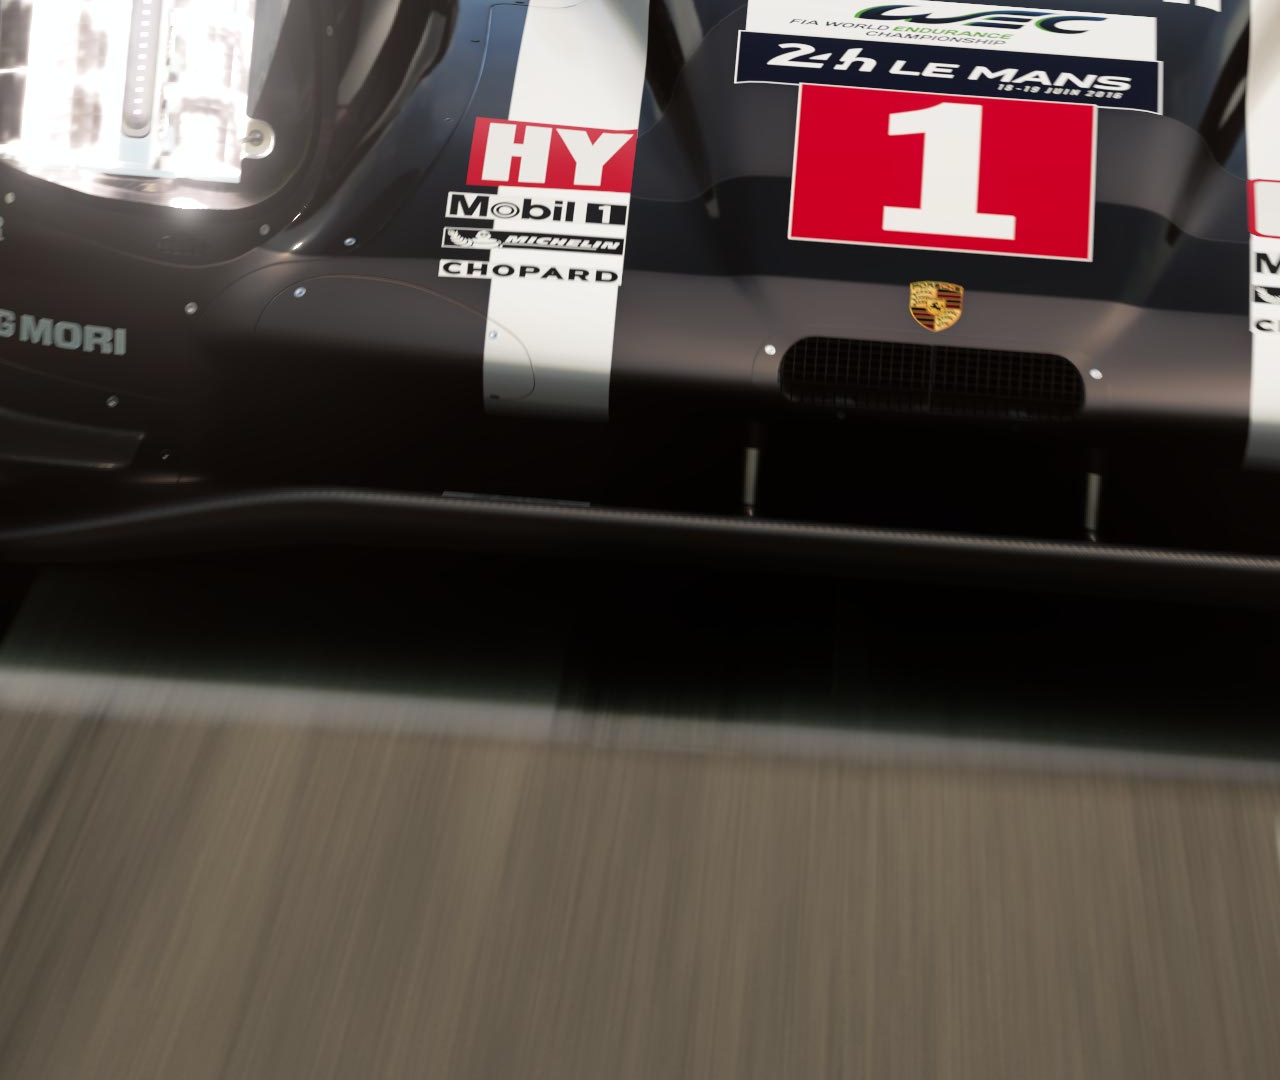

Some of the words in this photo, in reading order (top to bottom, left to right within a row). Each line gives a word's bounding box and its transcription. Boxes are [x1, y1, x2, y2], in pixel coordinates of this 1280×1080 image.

[789, 17, 820, 27] FIA
[821, 20, 890, 32] WORLD
[892, 25, 1015, 40] ENDURANCE
[854, 4, 1108, 35] WEC
[865, 30, 1008, 47] CHAMPIONSHIP
[888, 59, 961, 79] LE
[967, 65, 1133, 92] MANS
[1043, 87, 1081, 97] JUIN
[1084, 89, 1124, 100] 2016
[481, 122, 635, 187] HY
[881, 101, 1017, 241] 1
[449, 194, 576, 223] Mobil
[502, 234, 621, 251] MICHELIN
[442, 261, 619, 284] CHOPARD
[19, 313, 128, 356] MORI
